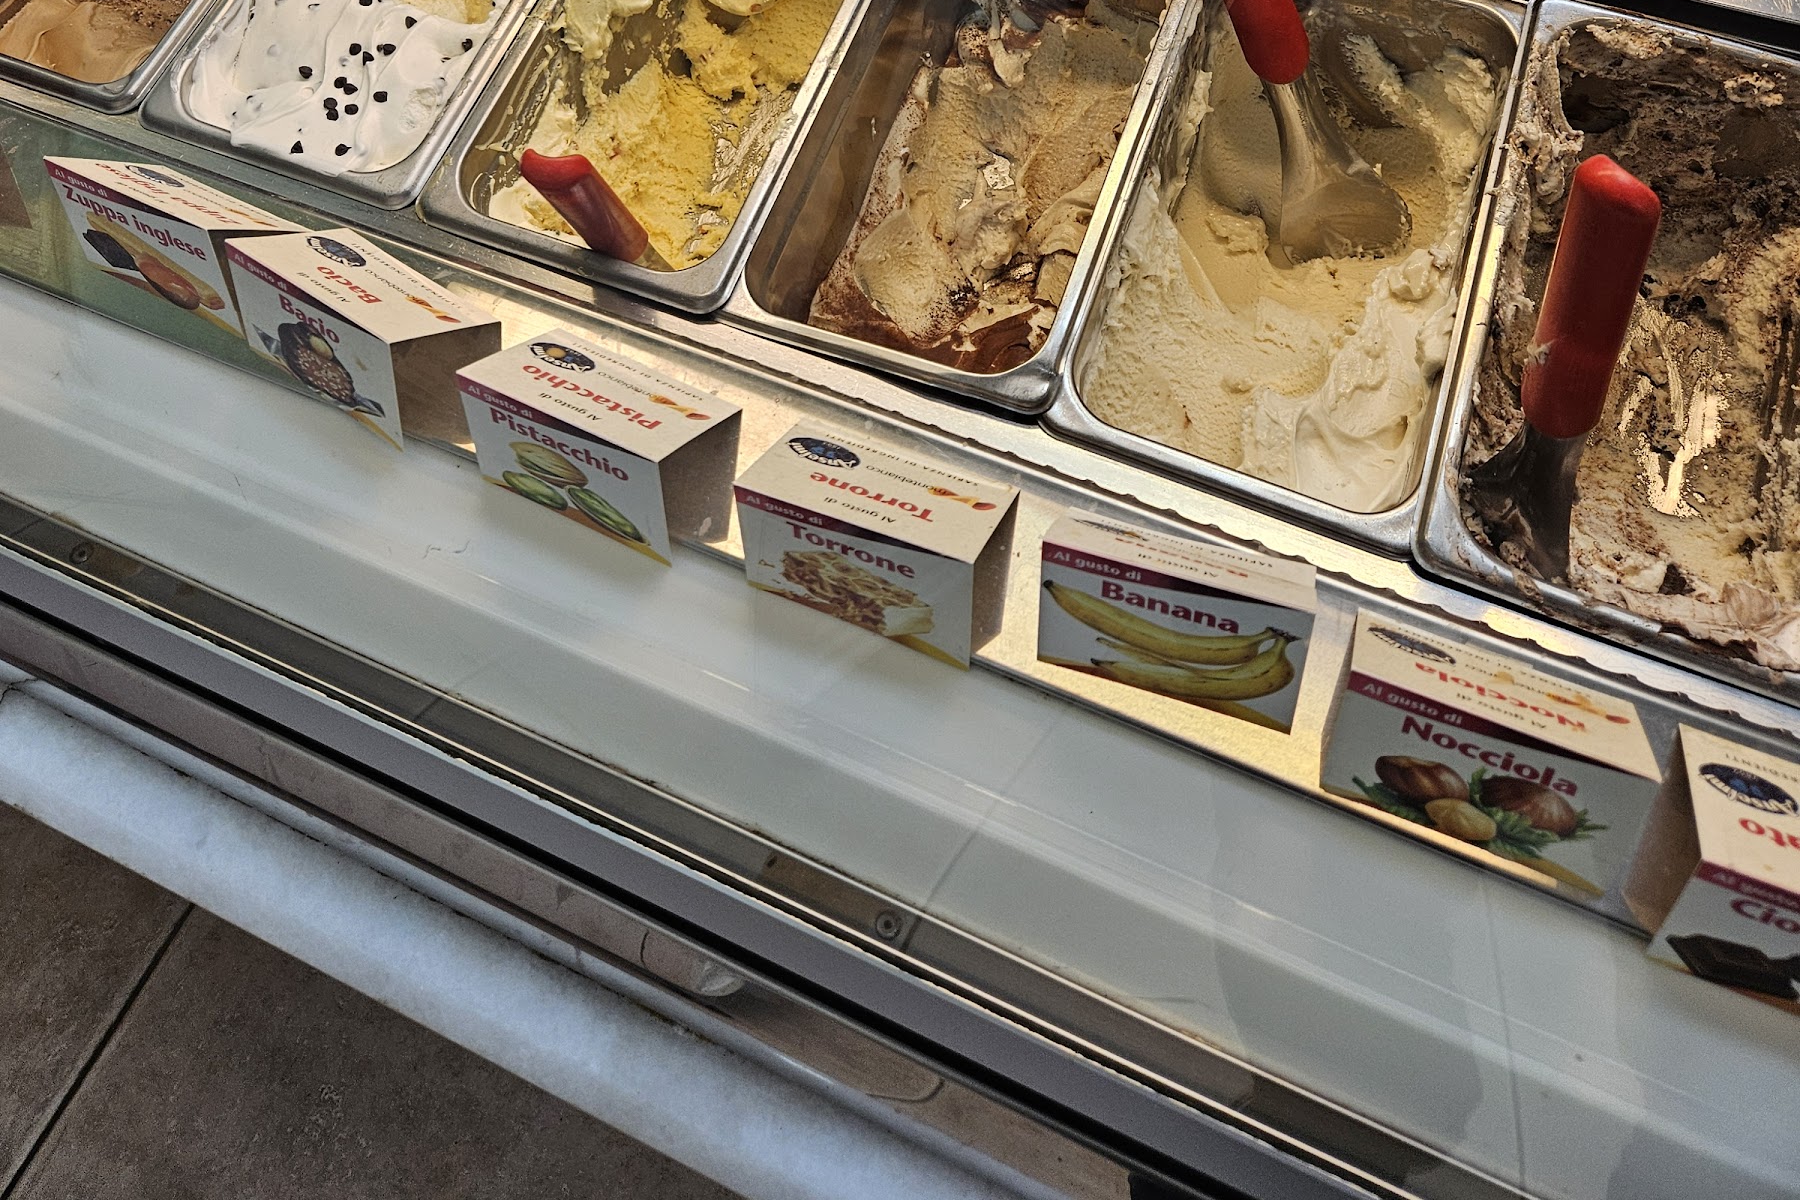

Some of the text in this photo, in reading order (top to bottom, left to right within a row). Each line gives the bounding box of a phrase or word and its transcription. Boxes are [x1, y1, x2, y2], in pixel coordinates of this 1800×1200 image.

[55, 168, 65, 179] Al
[68, 176, 95, 193] gusto
[97, 187, 108, 198] di
[62, 184, 129, 226] Zuppa
[132, 215, 207, 261] inglese
[234, 253, 287, 291] Al gusto di
[310, 278, 339, 297] gusto
[317, 266, 382, 304] Bacio
[279, 293, 340, 344] Bacio
[468, 385, 533, 419] Al gusto di
[522, 365, 664, 430] Pistacchio
[538, 392, 602, 422] Al gusto di
[489, 407, 629, 481] Pistacchio
[866, 464, 947, 495] montebianco
[922, 465, 979, 487] SAPIENZA
[746, 496, 823, 526] Al gusto di
[810, 471, 934, 522] Torrone
[823, 497, 897, 524] Al gusto di
[786, 521, 915, 579] Torrone
[1053, 550, 1142, 581] Al gusto di
[1101, 580, 1240, 635] Banana
[1364, 683, 1463, 725] Al gusto di
[1415, 661, 1586, 730] Nocciola
[1401, 715, 1578, 797] Nocciola
